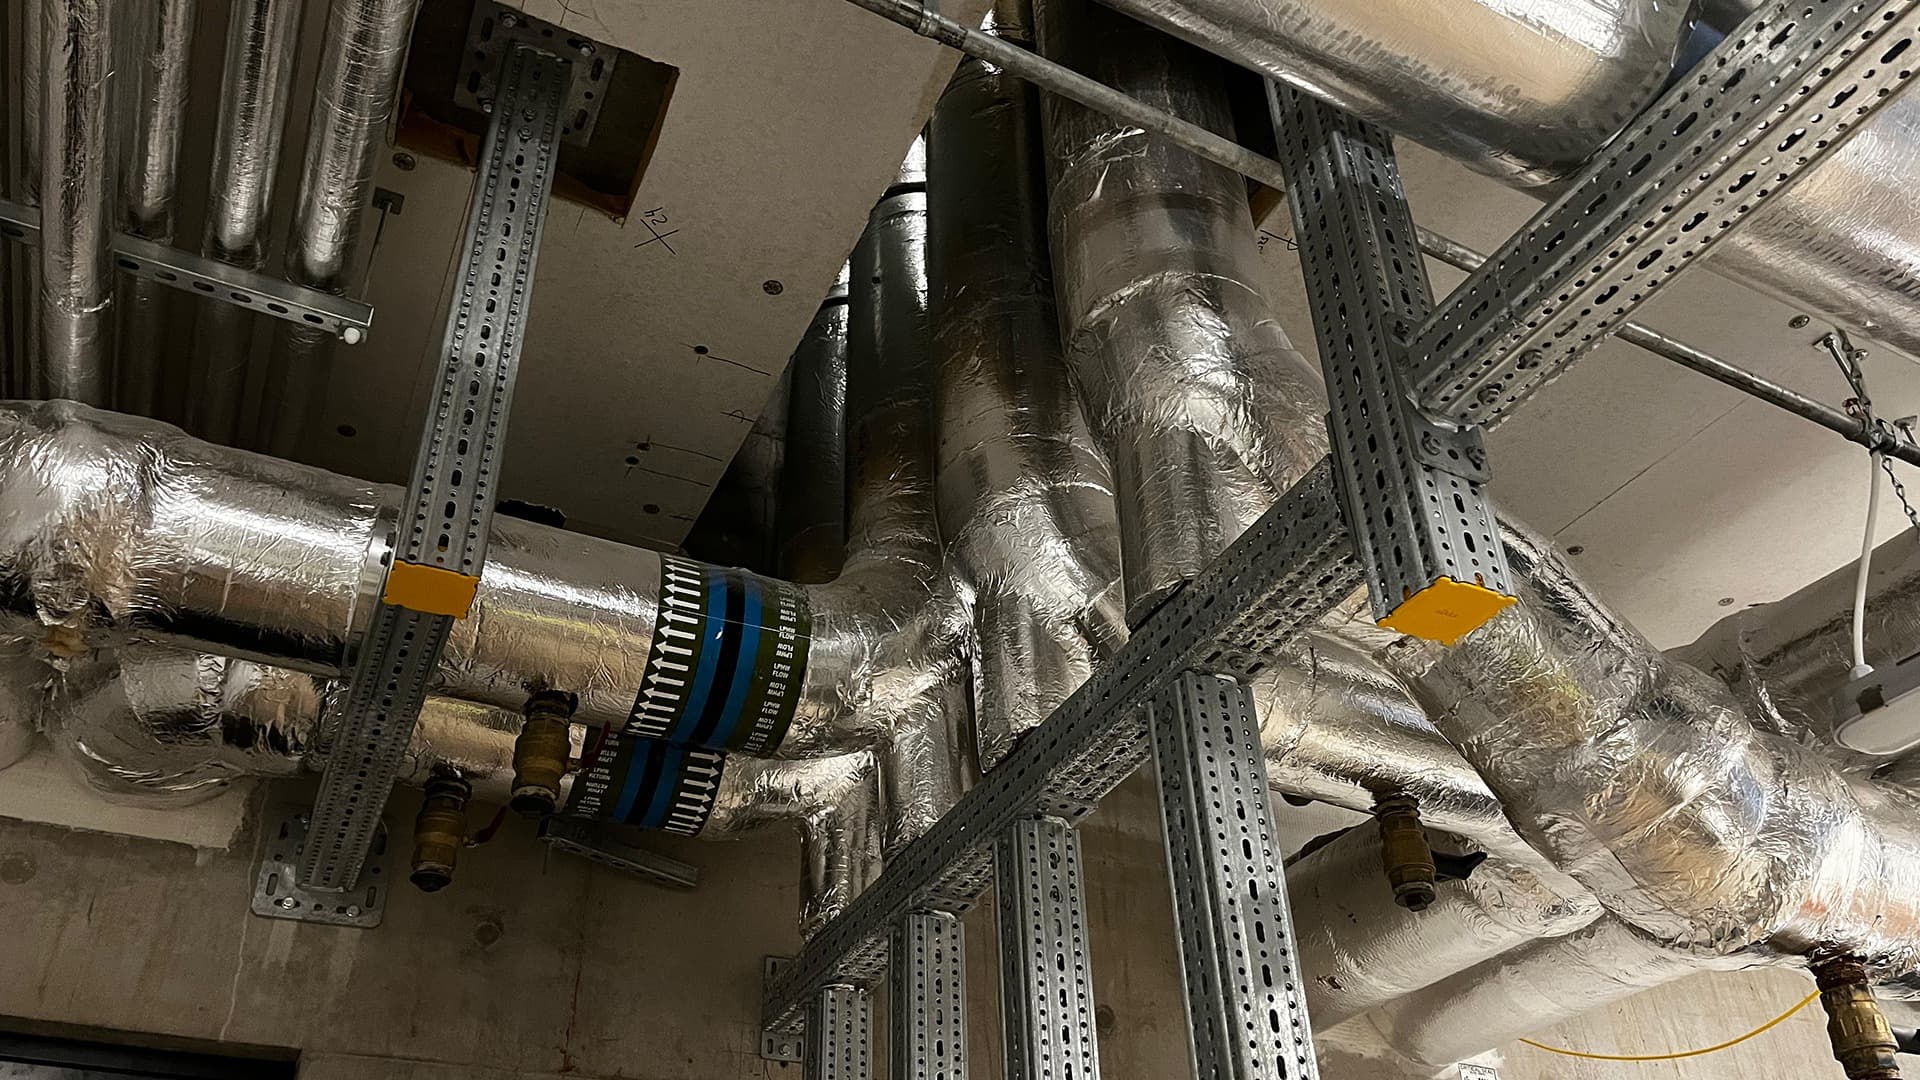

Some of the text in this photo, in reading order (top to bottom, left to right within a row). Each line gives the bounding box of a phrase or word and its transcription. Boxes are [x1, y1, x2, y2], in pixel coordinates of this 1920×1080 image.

[780, 626, 796, 634] LPHW
[779, 632, 795, 640] FLOW
[777, 643, 794, 652] FLOW
[776, 650, 793, 658] LPHW
[774, 662, 790, 672] LPHW
[772, 670, 789, 678] FLOW
[769, 682, 786, 690] FLOW
[768, 689, 784, 697] LPHW
